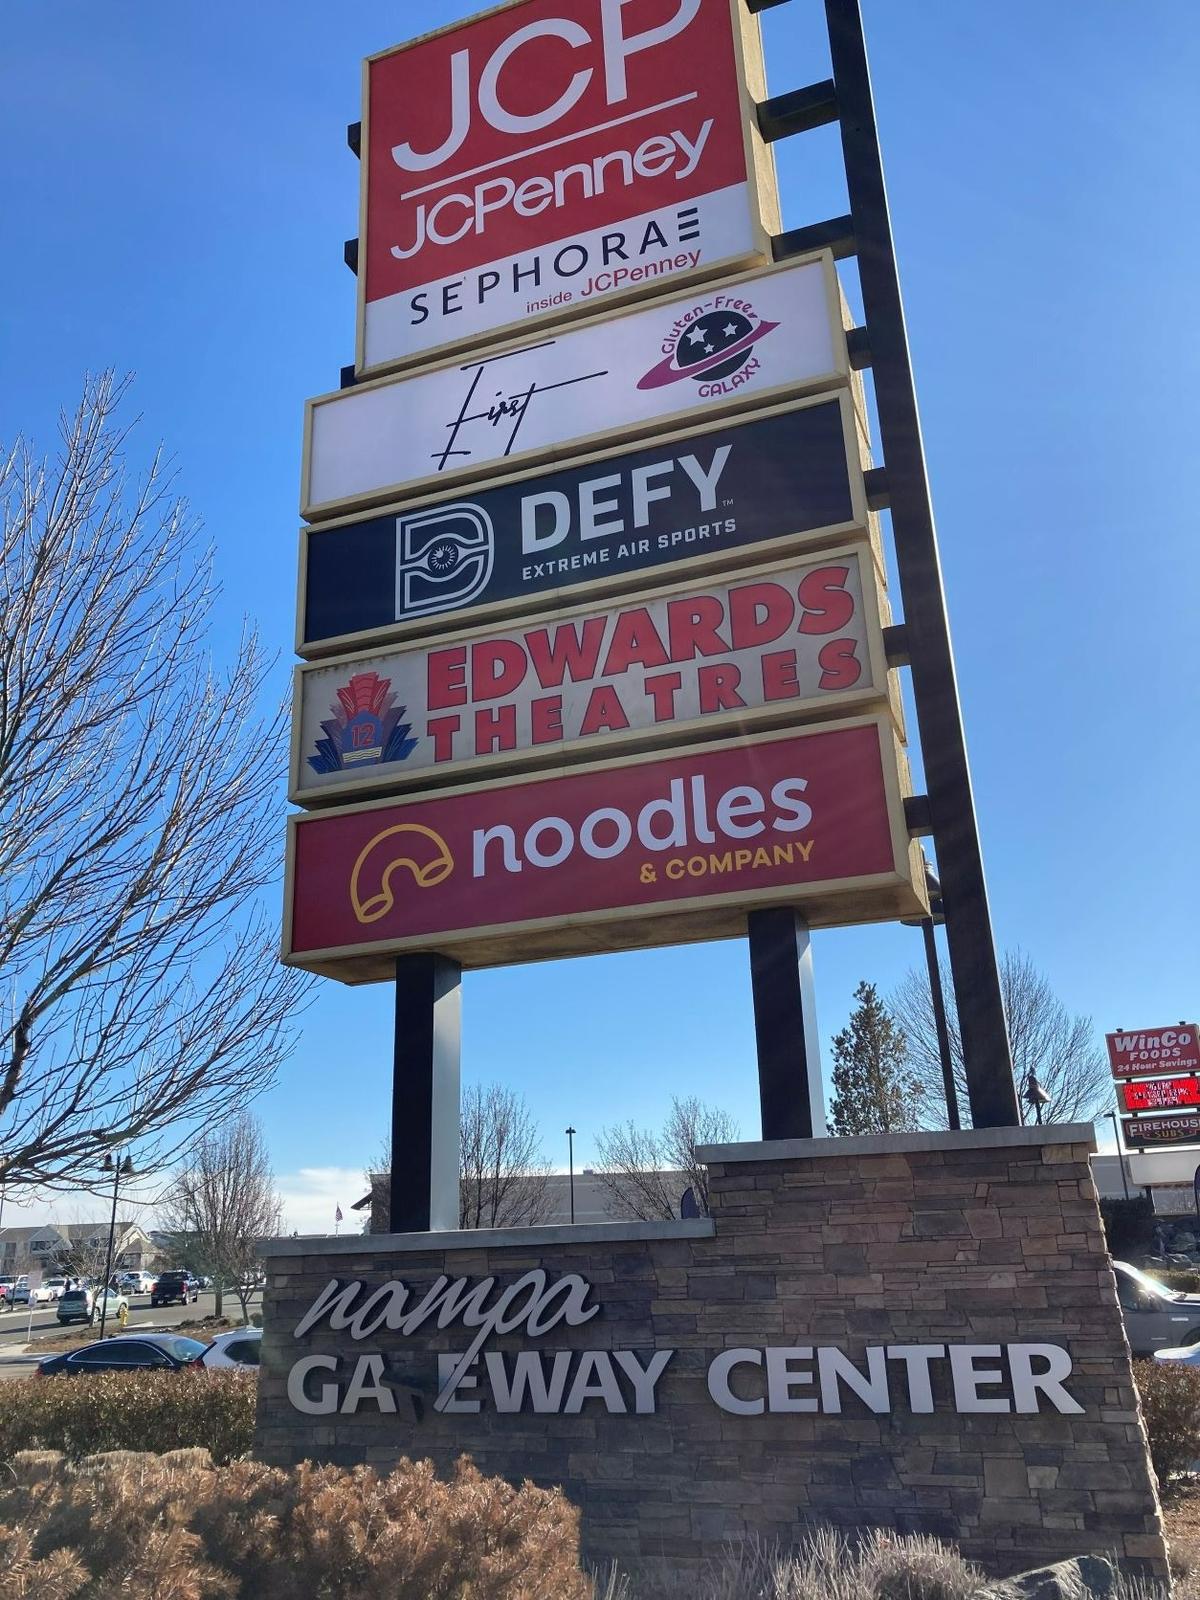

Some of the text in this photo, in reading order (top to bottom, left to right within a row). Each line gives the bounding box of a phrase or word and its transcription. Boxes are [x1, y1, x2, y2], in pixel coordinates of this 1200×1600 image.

[391, 0, 701, 172] JCP
[390, 118, 715, 260] JCPenney
[526, 249, 702, 314] inside JCPenney
[661, 296, 752, 354] Gluten-Free
[698, 357, 761, 398] GALAXY
[521, 444, 733, 555] DEFY
[522, 518, 737, 581] EXTREME AIR SPORTS
[427, 566, 855, 711] EDWARDS
[427, 638, 862, 763] THEATRES
[352, 722, 376, 748] 12
[472, 774, 814, 877] noodles
[638, 839, 815, 883] & COMPANY
[1114, 1031, 1191, 1052] WinCo
[1130, 1047, 1181, 1061] FOODS
[1132, 1062, 1157, 1071] Hour
[1159, 1058, 1198, 1068] Savings
[1154, 1129, 1185, 1137] SUBS
[287, 1342, 1087, 1416] GAEWAY CENTER
